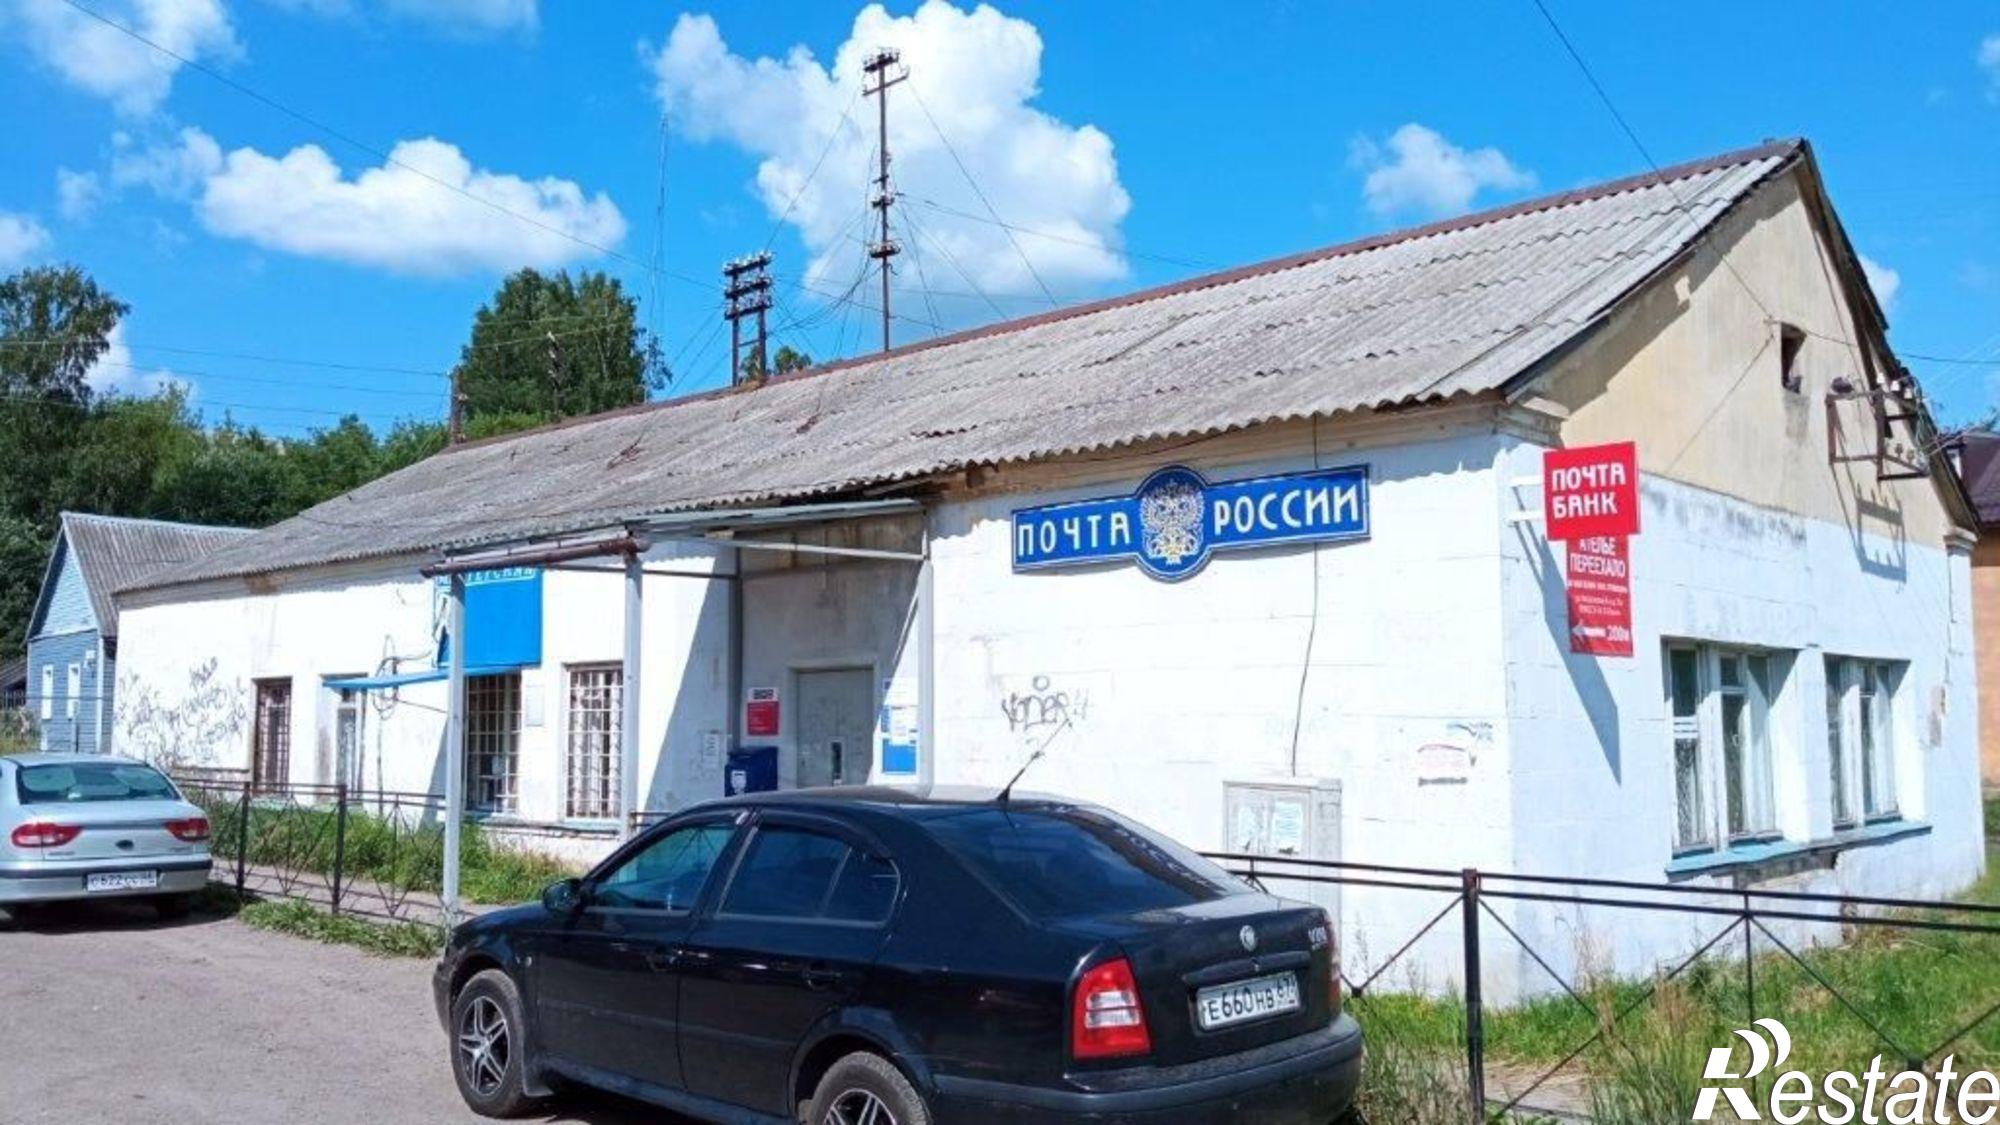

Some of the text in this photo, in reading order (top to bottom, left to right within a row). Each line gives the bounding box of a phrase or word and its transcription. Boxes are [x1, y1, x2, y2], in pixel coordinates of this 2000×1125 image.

[1552, 462, 1626, 491] ПОЧТА
[1553, 491, 1618, 519] БАНК
[1018, 484, 1358, 556] ПОЧТА РОССИИ
[1570, 552, 1626, 578] ПЕРЕЕХАЛО
